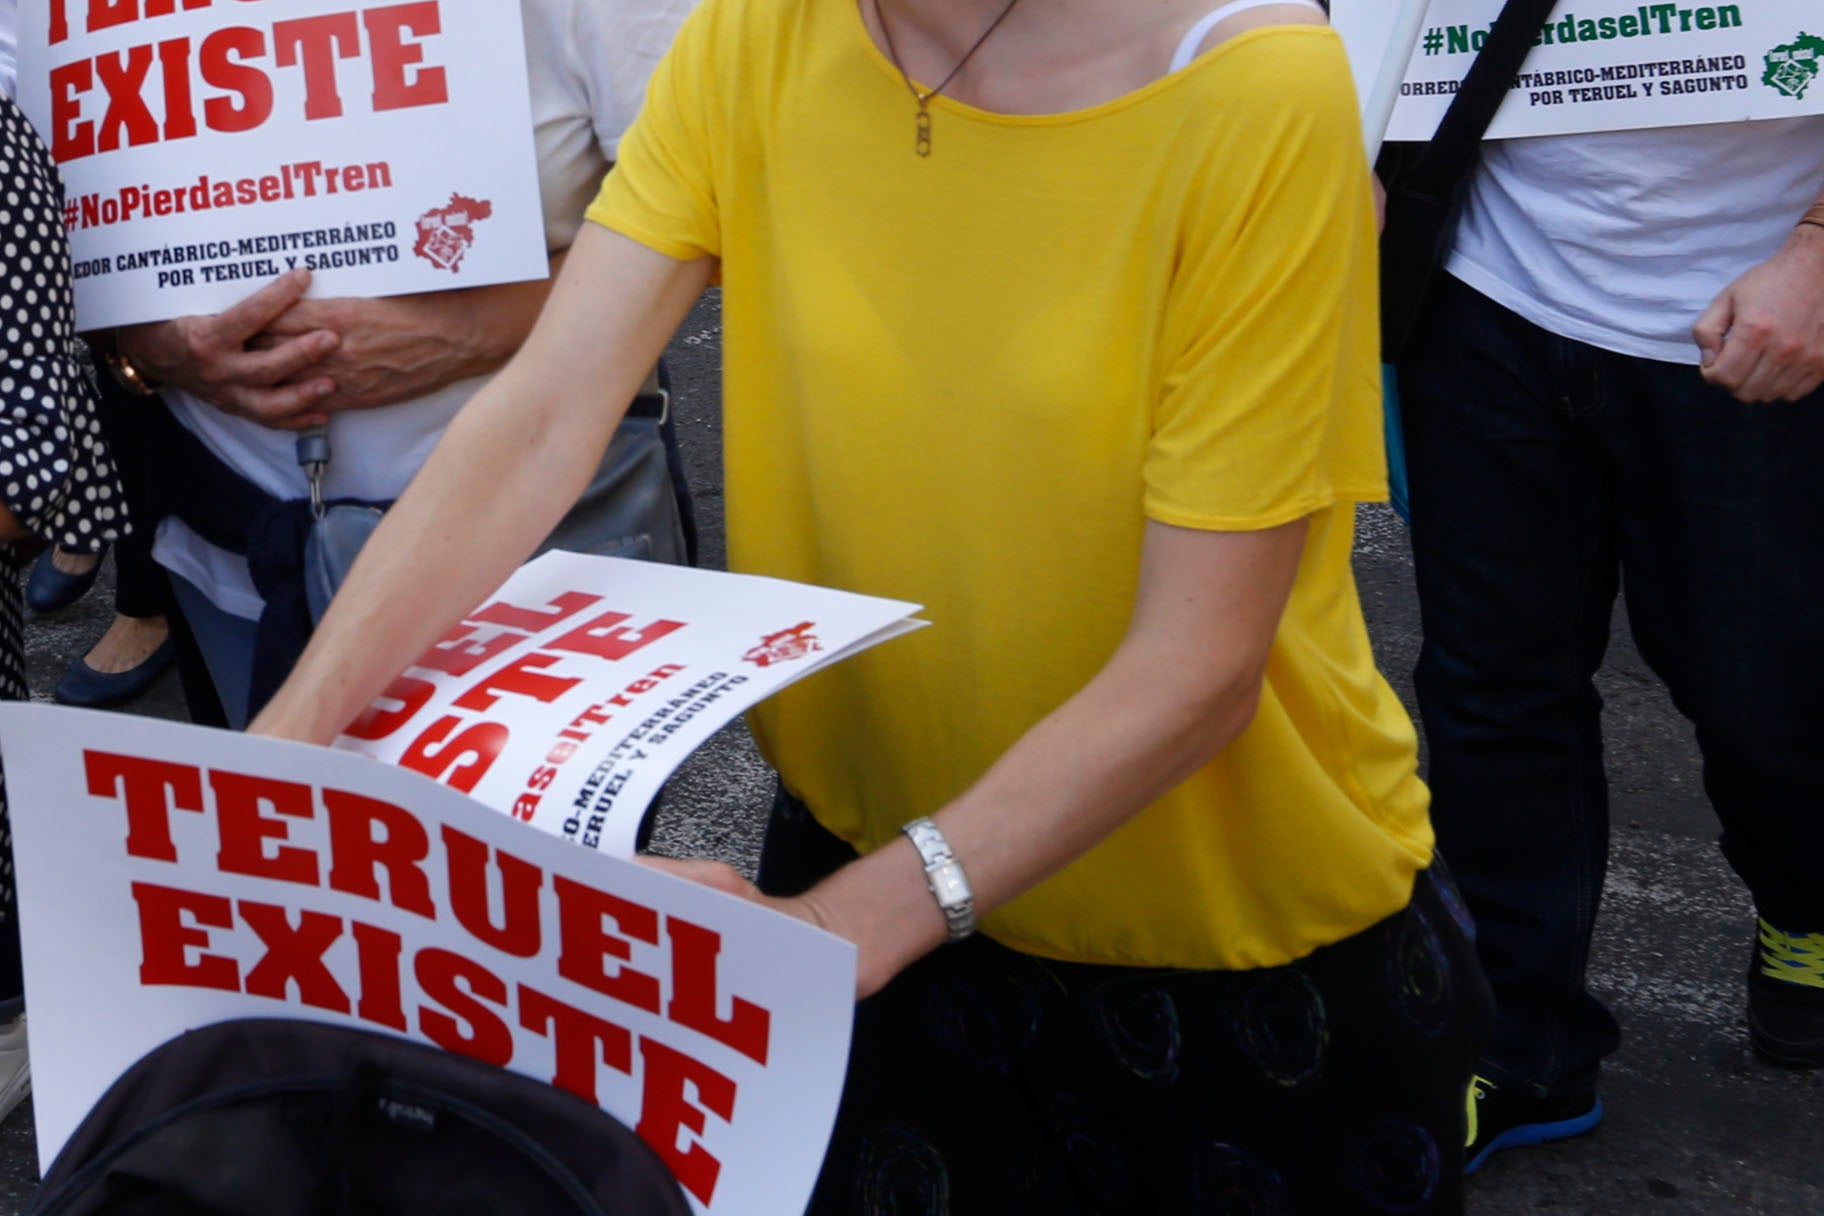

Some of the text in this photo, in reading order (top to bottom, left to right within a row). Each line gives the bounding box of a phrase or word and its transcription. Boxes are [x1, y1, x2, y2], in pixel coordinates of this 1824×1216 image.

[49, 0, 450, 163] EXISTE
[1400, 55, 1745, 97] ORRED NTÁBRICO-MEDITERRÁNEO
[1529, 75, 1749, 107] POR TERUEL Y SAGUNTO
[63, 161, 392, 233] #NoPierdaselTren
[74, 221, 397, 280] EDOR CANTÁBRICO-MEDITERRÁNEO
[158, 244, 400, 289] POR TERUEL Y SAGUNTO
[341, 590, 606, 741] UEL
[397, 611, 690, 795] STE
[511, 663, 688, 824] aselTren
[582, 673, 749, 850] ERUEL Y SAGUNTO
[82, 748, 772, 1068] TERUEL
[129, 879, 738, 1209] EXISTE
